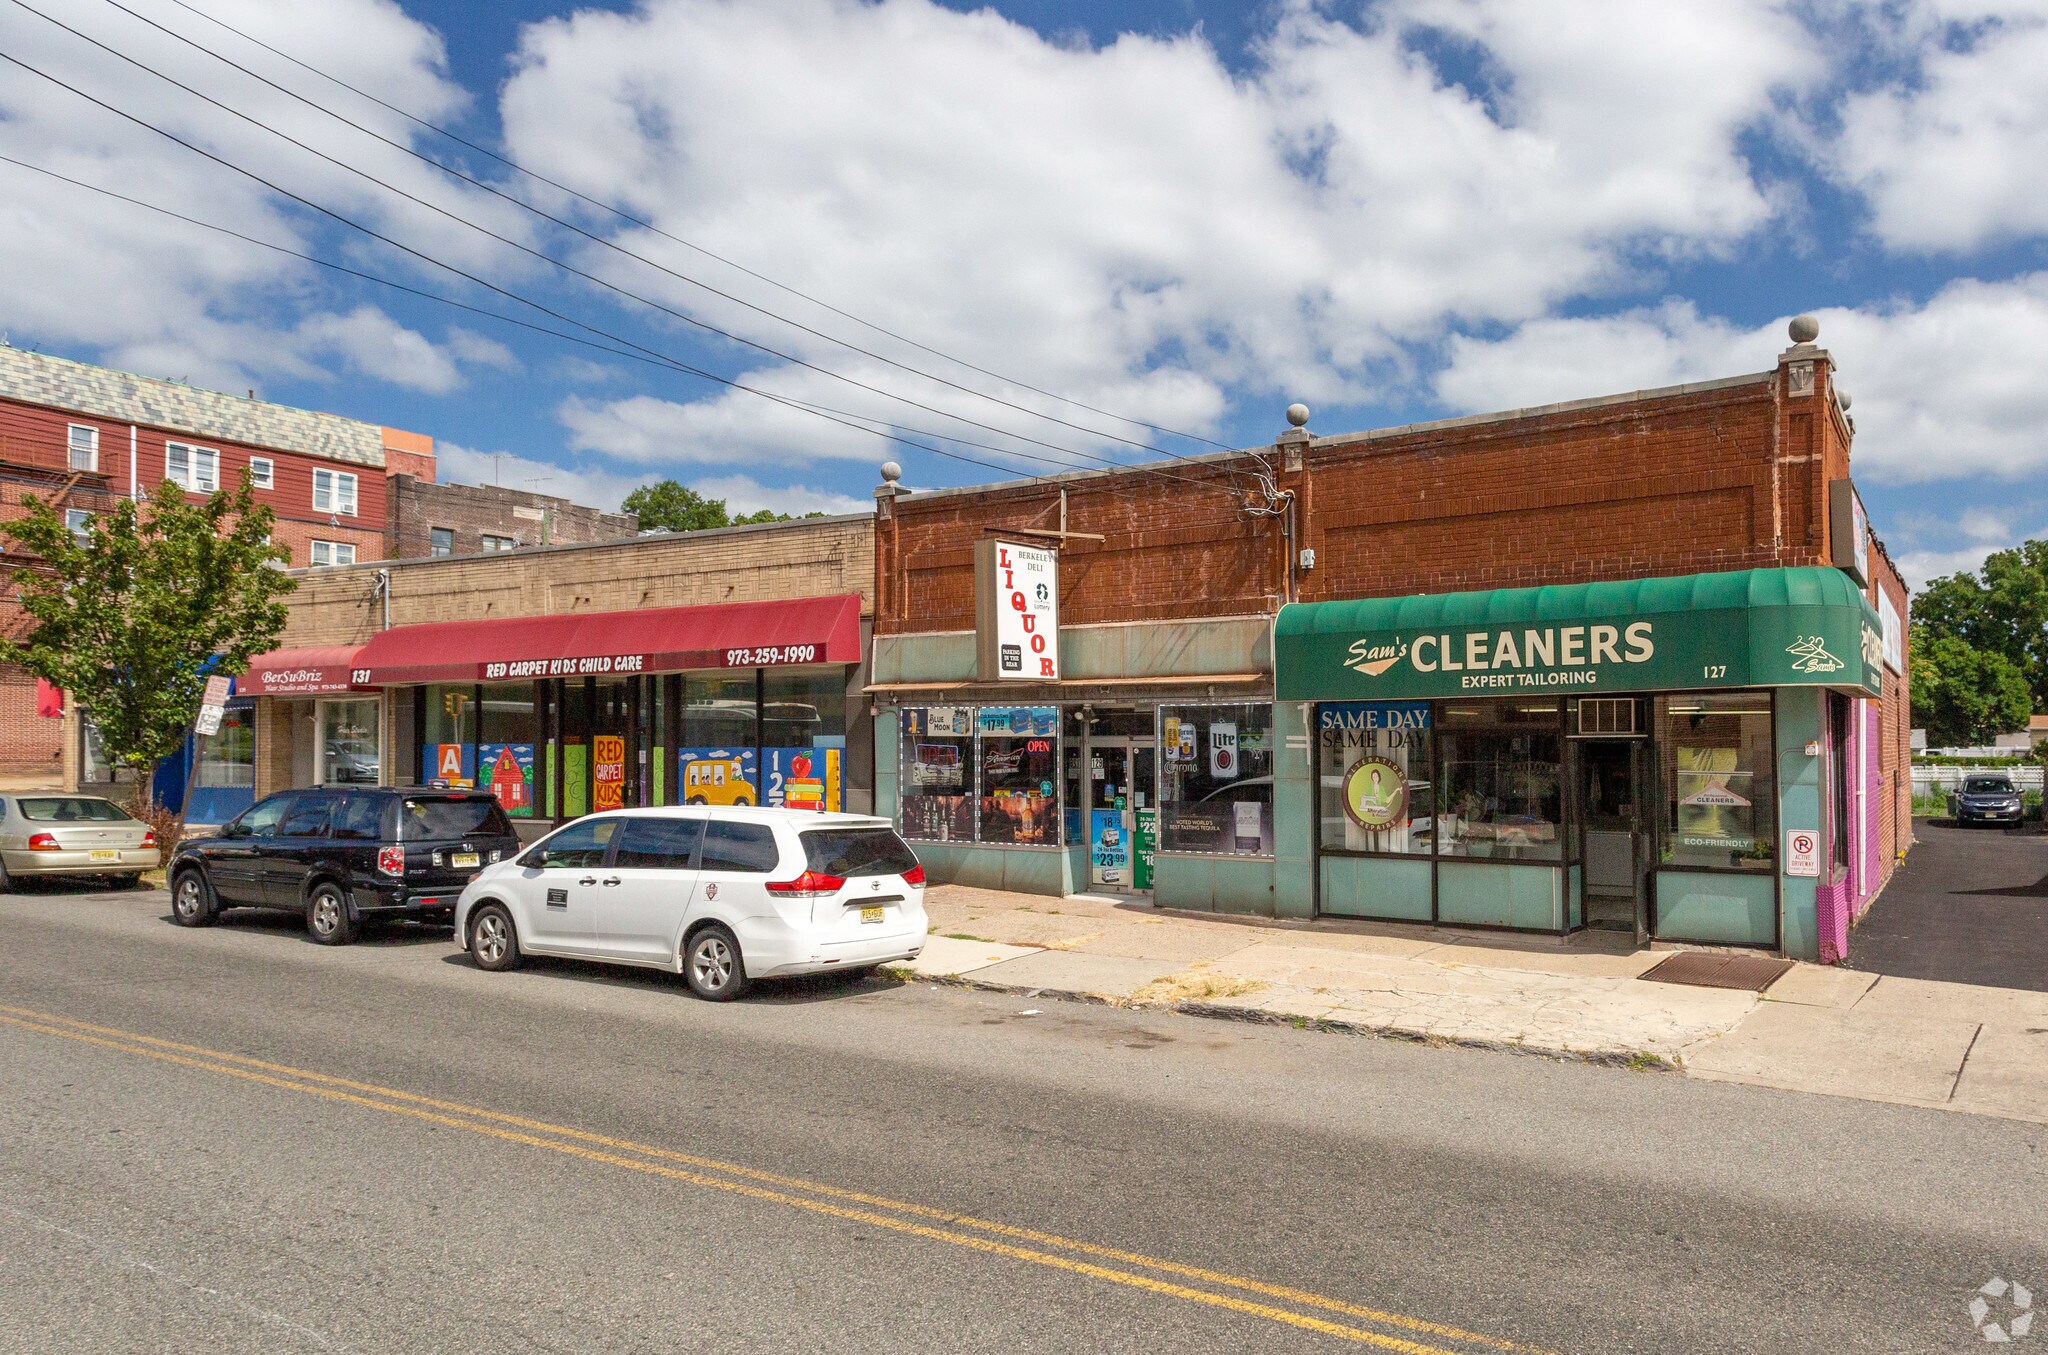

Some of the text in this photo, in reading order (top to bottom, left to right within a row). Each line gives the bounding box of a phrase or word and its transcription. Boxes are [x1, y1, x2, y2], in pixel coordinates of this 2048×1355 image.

[1018, 550, 1053, 563] BERKELEY
[1027, 562, 1043, 572] DELI
[1000, 548, 1055, 677] LIQUOR
[727, 645, 815, 666] 973-259-1990
[1343, 621, 1655, 673] Sam's CLEANERS
[351, 669, 371, 683] 131
[486, 655, 643, 678] RED CARPET KIDS CHILD CARE
[1704, 665, 1727, 679] 127
[1462, 670, 1597, 689] EXPERT TAILORING
[934, 723, 951, 731] MOON
[1322, 709, 1428, 729] SAME DAY
[598, 740, 623, 762] RED
[1027, 740, 1050, 752] OPEN
[1212, 733, 1235, 750] Lite
[441, 748, 460, 774] A
[772, 750, 779, 771] 1
[1347, 756, 1407, 784] ALTERATIONS
[596, 763, 623, 780] CARPET
[596, 783, 622, 804] KIDS
[768, 772, 784, 798] 2
[1360, 820, 1396, 831] REPAIRS
[1684, 837, 1749, 848] ECO-FRIENDLY
[1096, 852, 1125, 867] $23.99
